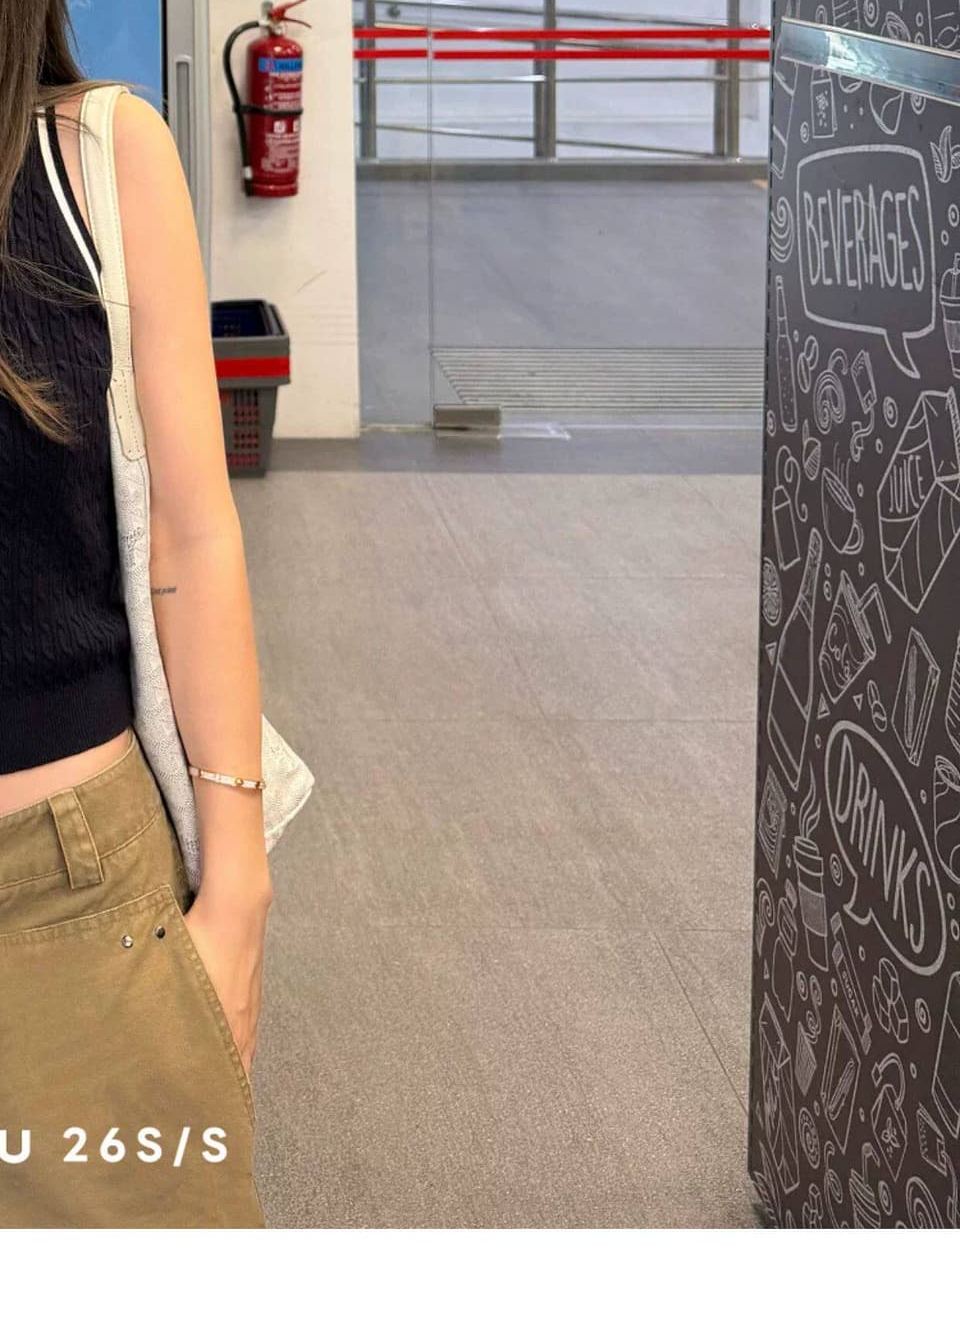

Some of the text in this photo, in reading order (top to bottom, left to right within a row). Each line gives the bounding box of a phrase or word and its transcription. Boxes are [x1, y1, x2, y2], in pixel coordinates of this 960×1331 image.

[803, 183, 925, 292] BEVERAGES
[889, 454, 926, 514] JUICE
[835, 734, 931, 954] DRINKS
[842, 971, 861, 1018] SUGAR
